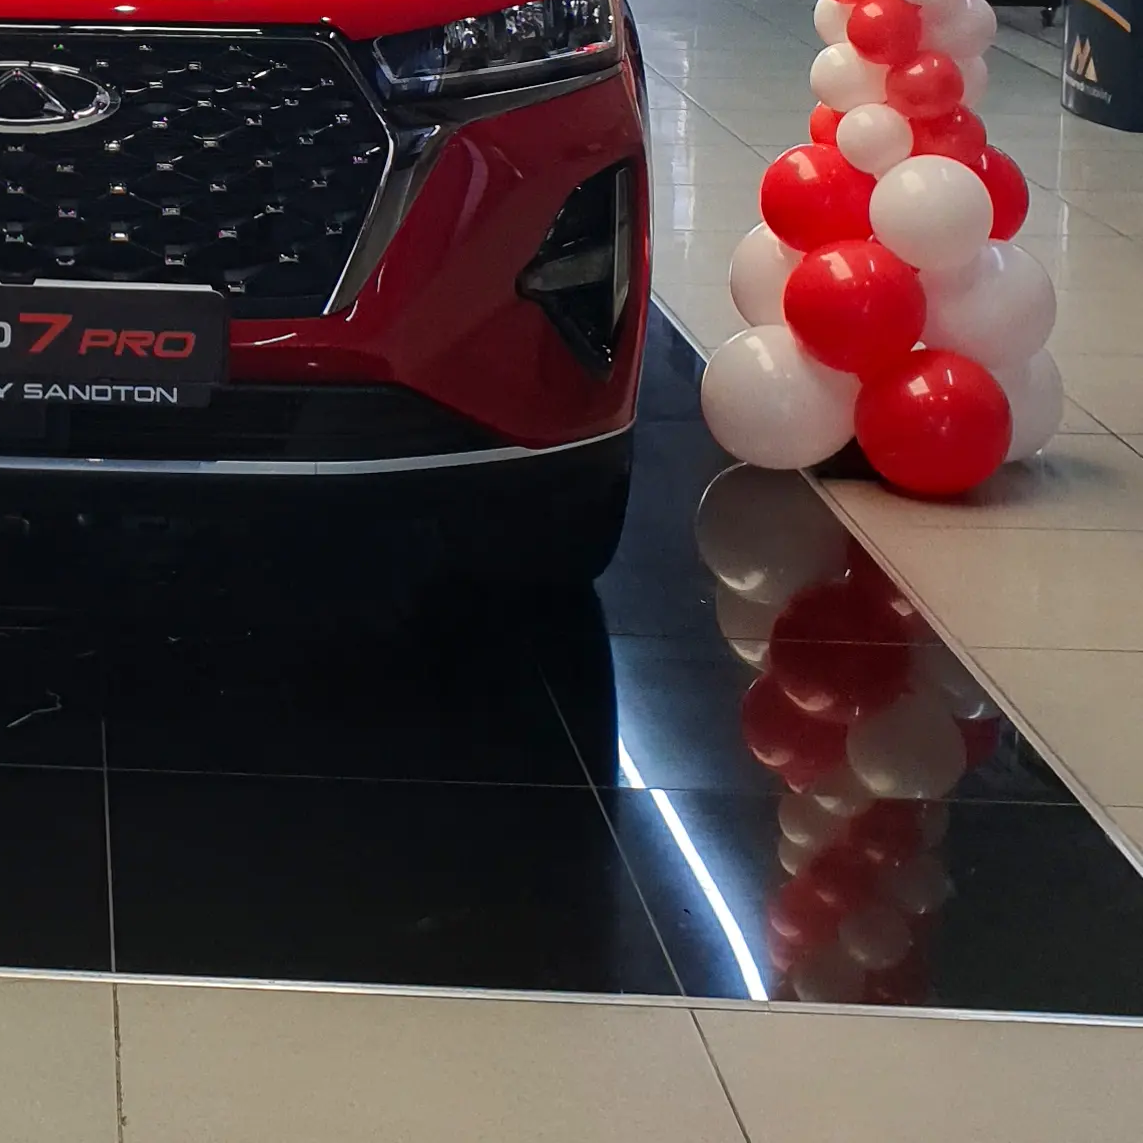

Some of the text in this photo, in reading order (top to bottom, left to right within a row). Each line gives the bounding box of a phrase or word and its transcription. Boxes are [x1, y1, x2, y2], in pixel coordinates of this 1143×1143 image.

[19, 312, 74, 354] 7
[77, 328, 197, 358] PRO
[23, 382, 178, 404] SANDTON
